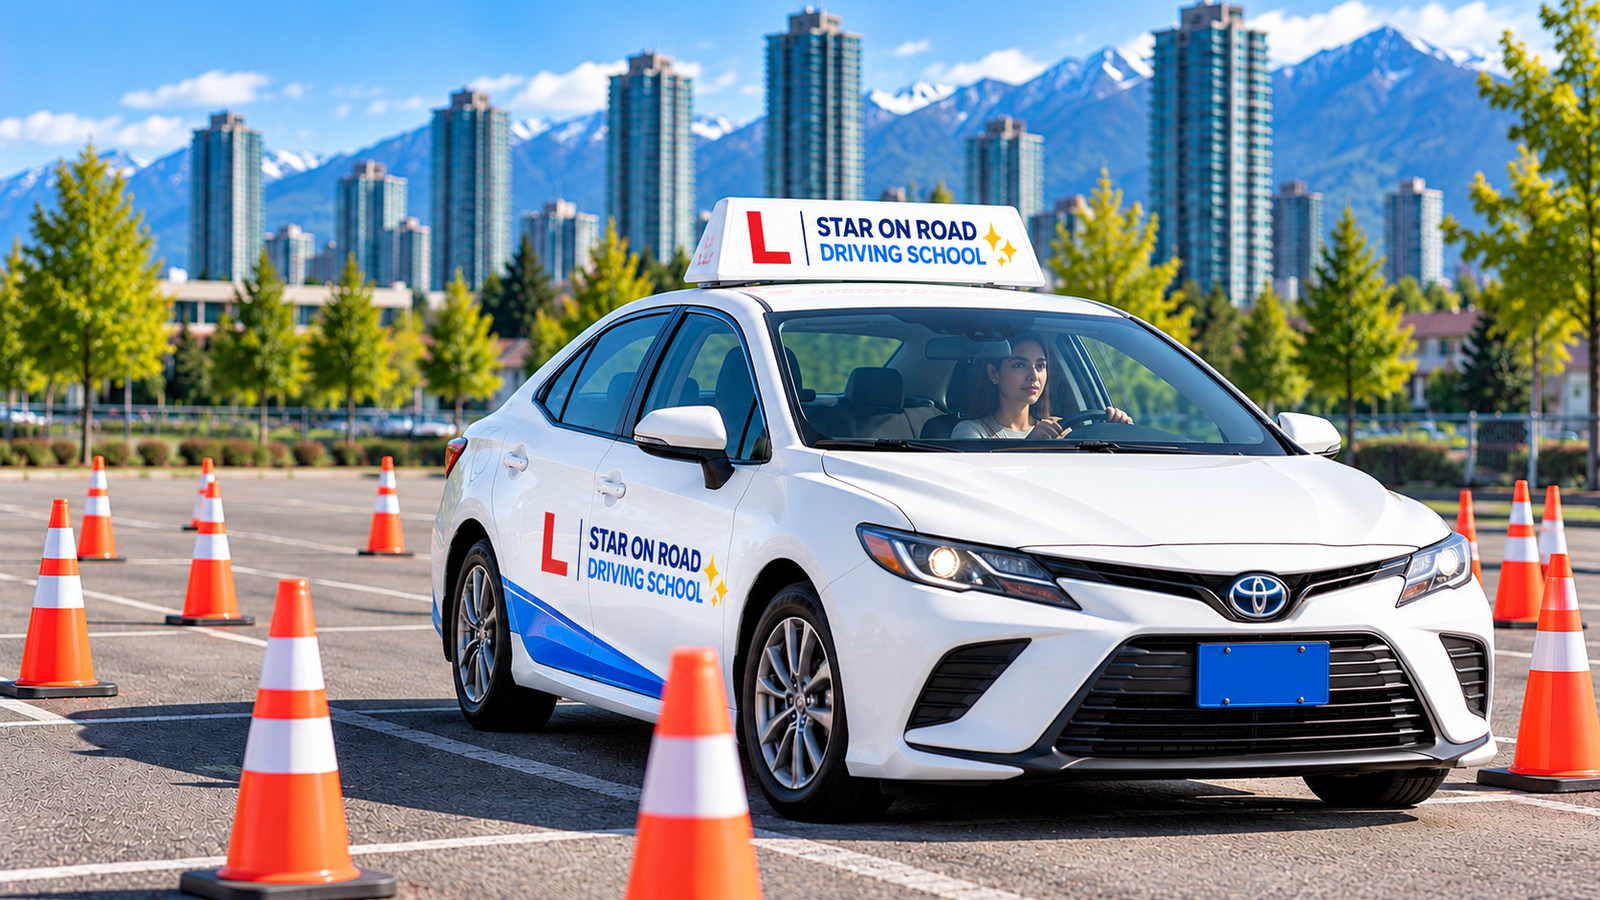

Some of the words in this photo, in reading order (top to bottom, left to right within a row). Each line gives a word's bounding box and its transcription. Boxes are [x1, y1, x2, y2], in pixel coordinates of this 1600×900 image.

[746, 210, 792, 265] L
[816, 216, 874, 239] STAR
[878, 218, 912, 240] ON
[915, 220, 977, 241] ROAD
[820, 243, 902, 264] DRIVING
[906, 245, 987, 266] SCHOOL
[540, 511, 568, 577] L
[589, 525, 629, 558] STAR
[630, 535, 655, 564] ON
[657, 541, 702, 573] ROAD
[587, 557, 645, 590] DRIVING
[646, 570, 704, 604] SCHOOL
